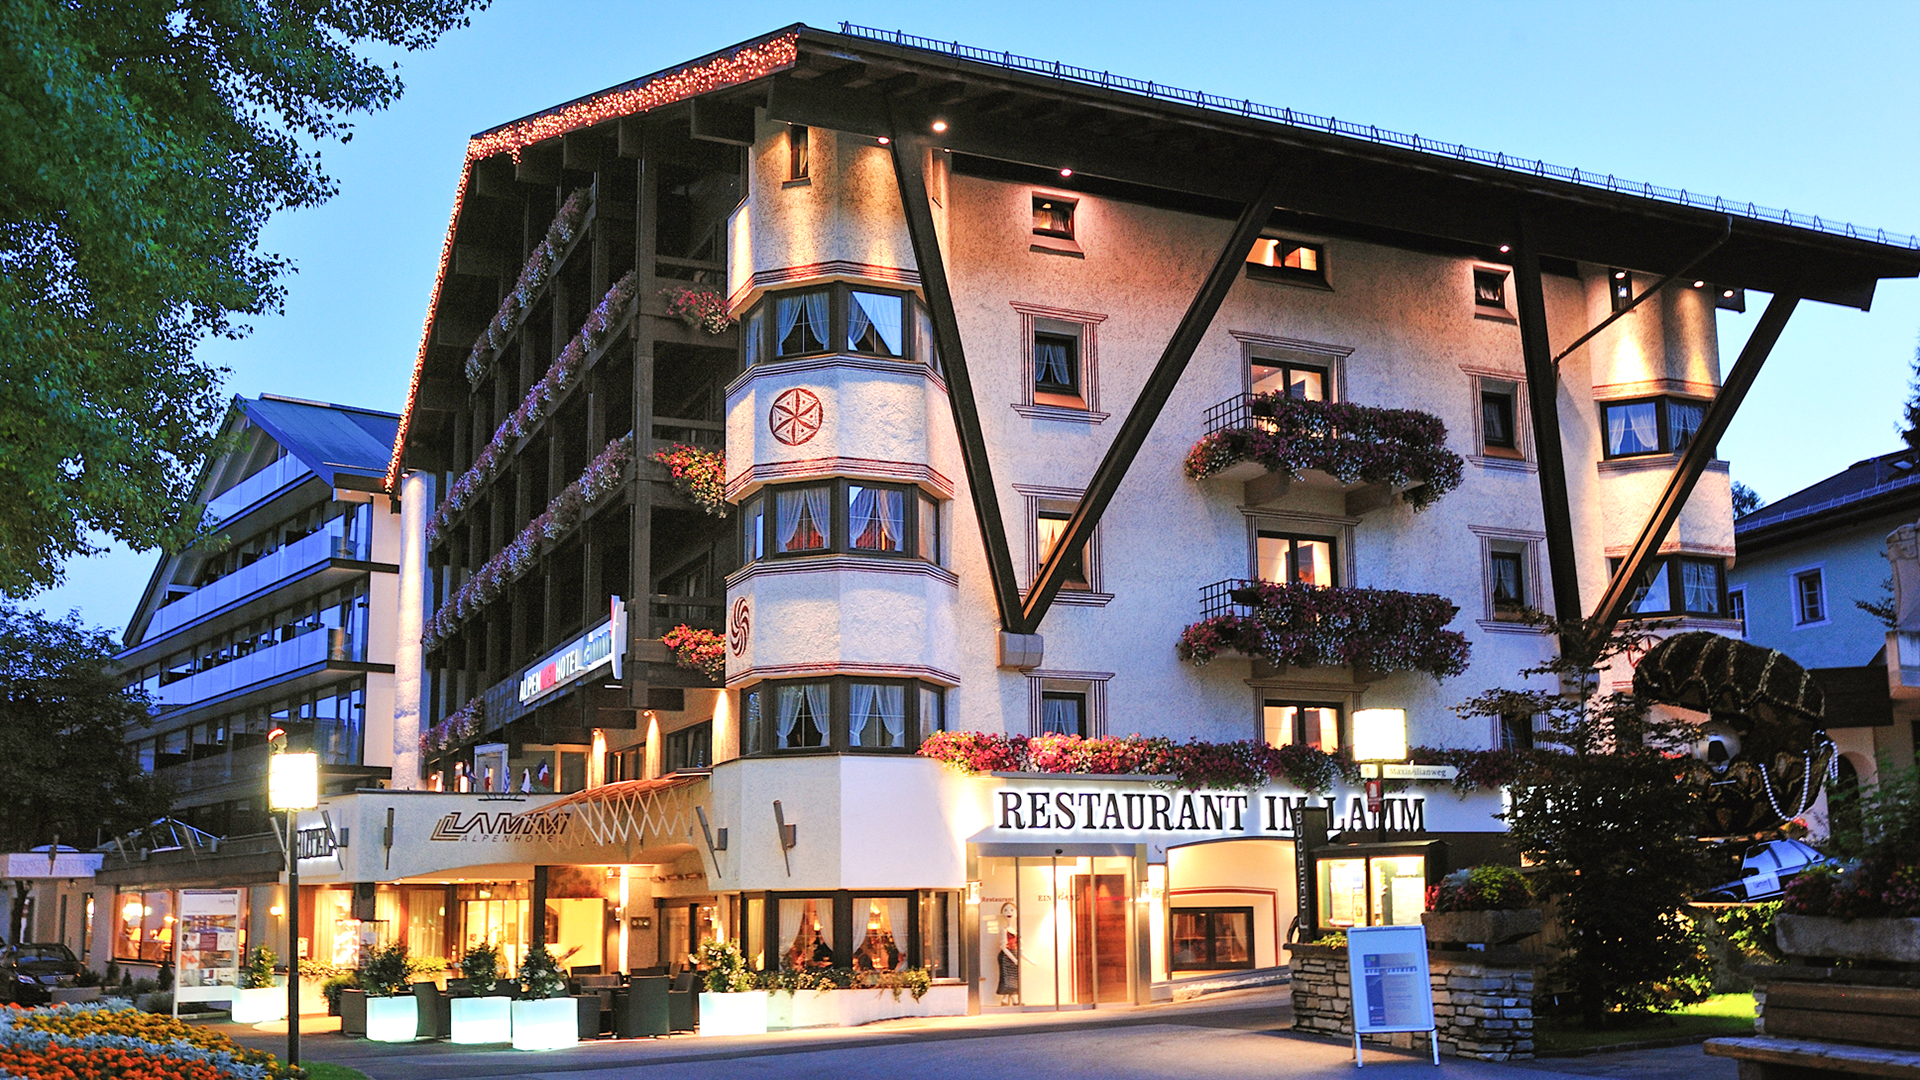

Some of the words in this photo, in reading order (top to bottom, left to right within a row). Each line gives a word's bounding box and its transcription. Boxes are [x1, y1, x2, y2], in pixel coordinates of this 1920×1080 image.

[998, 791, 1247, 831] RESTAURANT
[1265, 796, 1308, 830] IM
[432, 812, 571, 838] LAMM
[461, 834, 562, 843] ALPENHOTE
